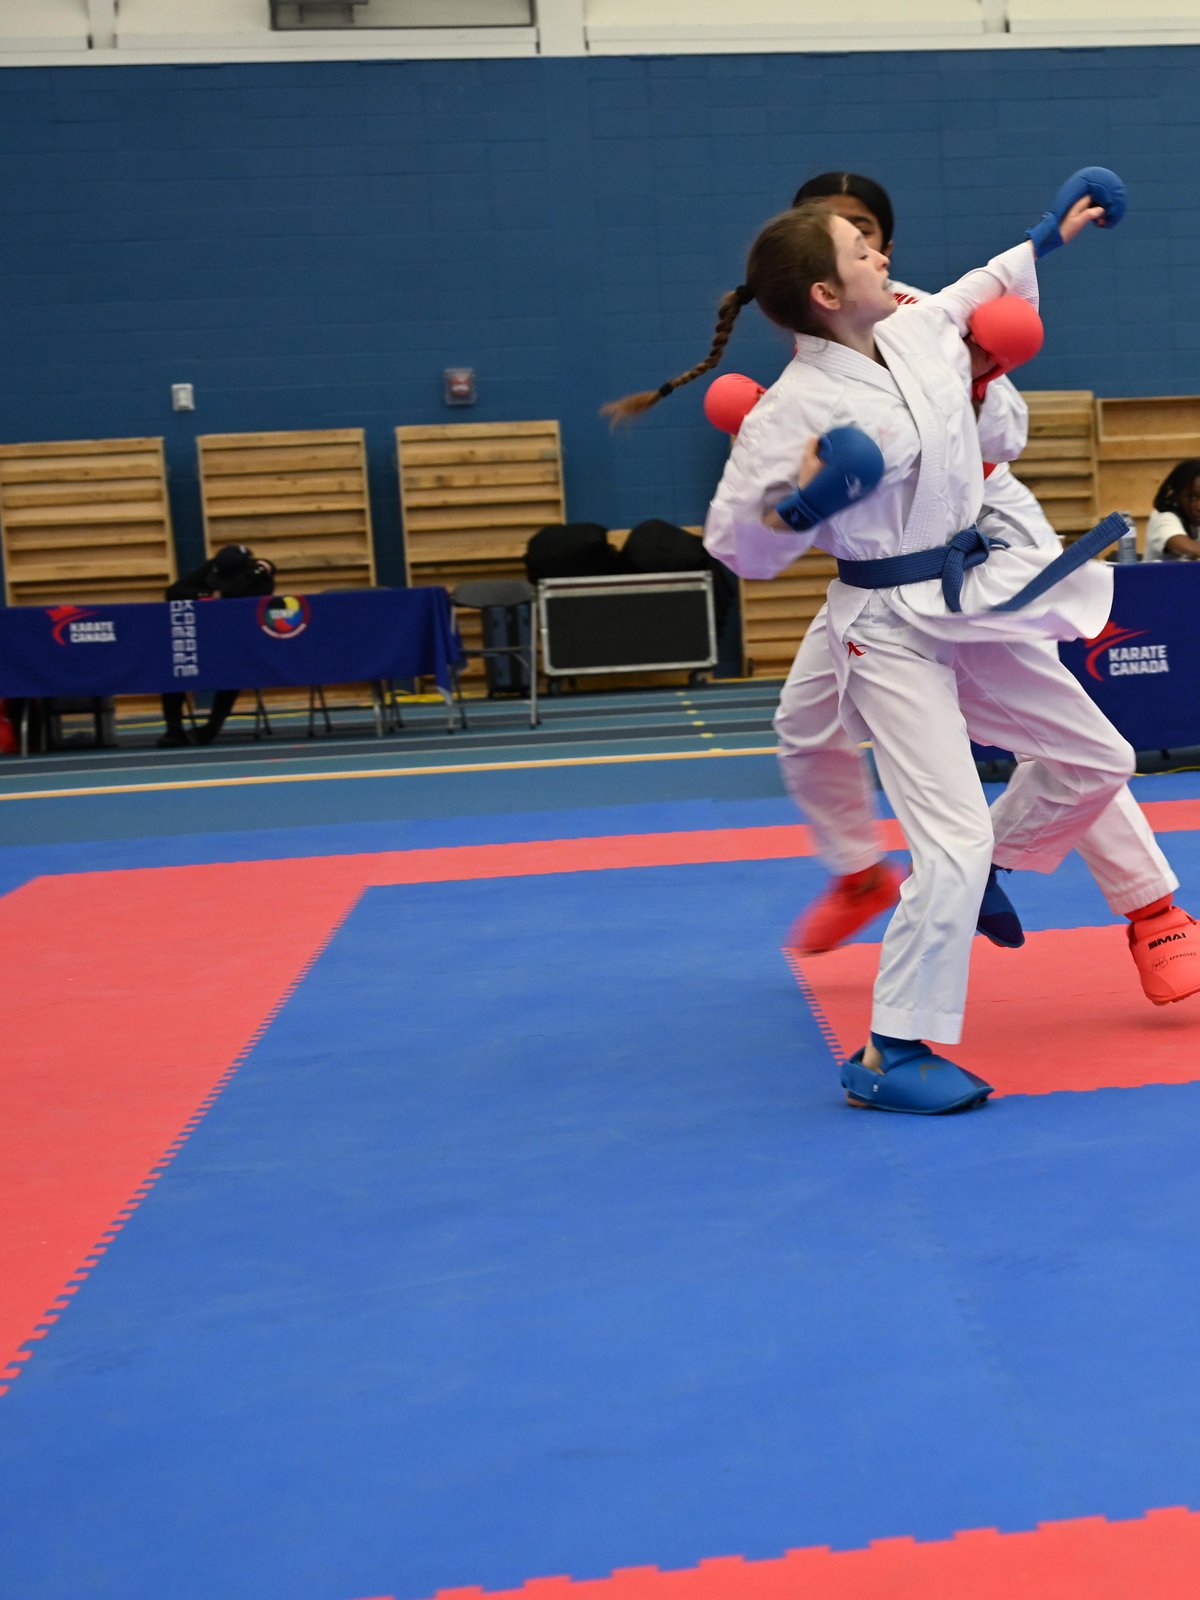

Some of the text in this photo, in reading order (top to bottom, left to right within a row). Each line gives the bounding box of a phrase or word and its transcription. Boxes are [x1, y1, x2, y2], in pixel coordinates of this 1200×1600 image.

[1109, 644, 1167, 662] KARATE
[1109, 659, 1169, 676] CANADA
[1148, 932, 1187, 950] SMAI
